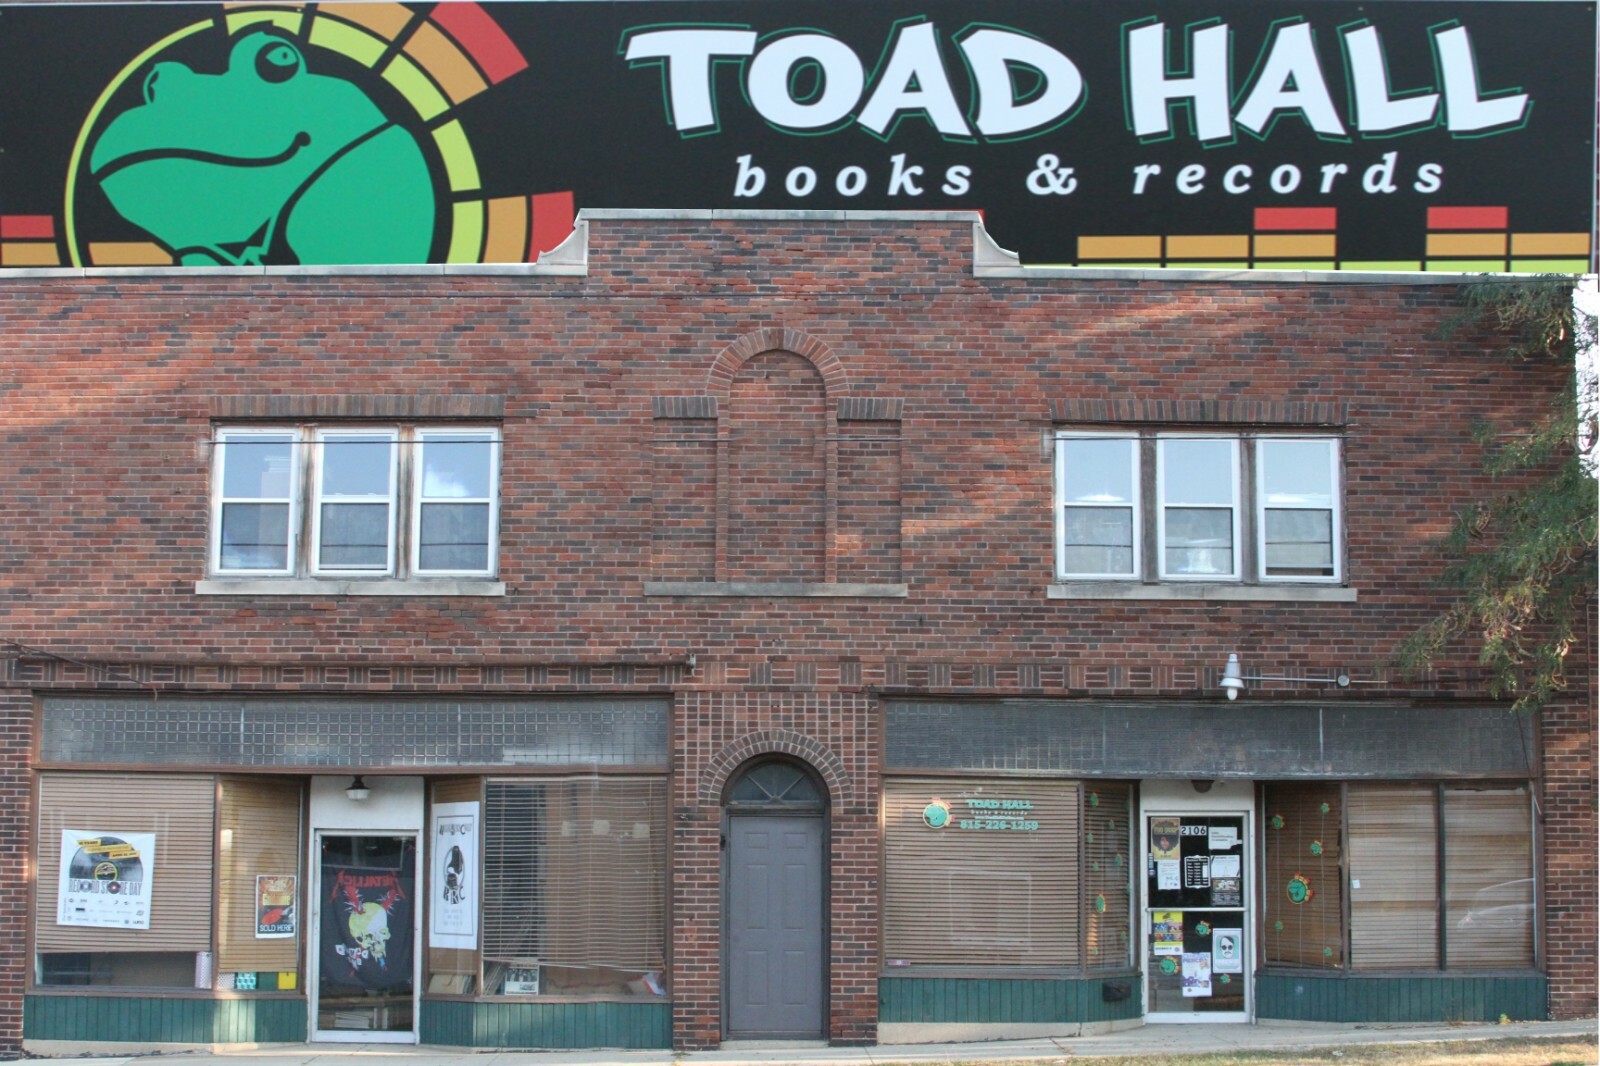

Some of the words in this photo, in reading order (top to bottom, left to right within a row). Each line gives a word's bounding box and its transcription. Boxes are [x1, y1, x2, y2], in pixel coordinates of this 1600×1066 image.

[624, 21, 1084, 137] TOAD
[1128, 22, 1529, 141] HALL
[734, 153, 972, 197] books
[1026, 153, 1078, 195] &
[1132, 151, 1443, 195] records
[966, 799, 1000, 809] TOAD
[1002, 800, 1034, 809] HALL
[960, 820, 1039, 831] 815-226-1259
[1181, 826, 1206, 835] 2106
[129, 881, 143, 896] DAY
[260, 924, 276, 932] SOLD
[277, 924, 292, 932] HERE
